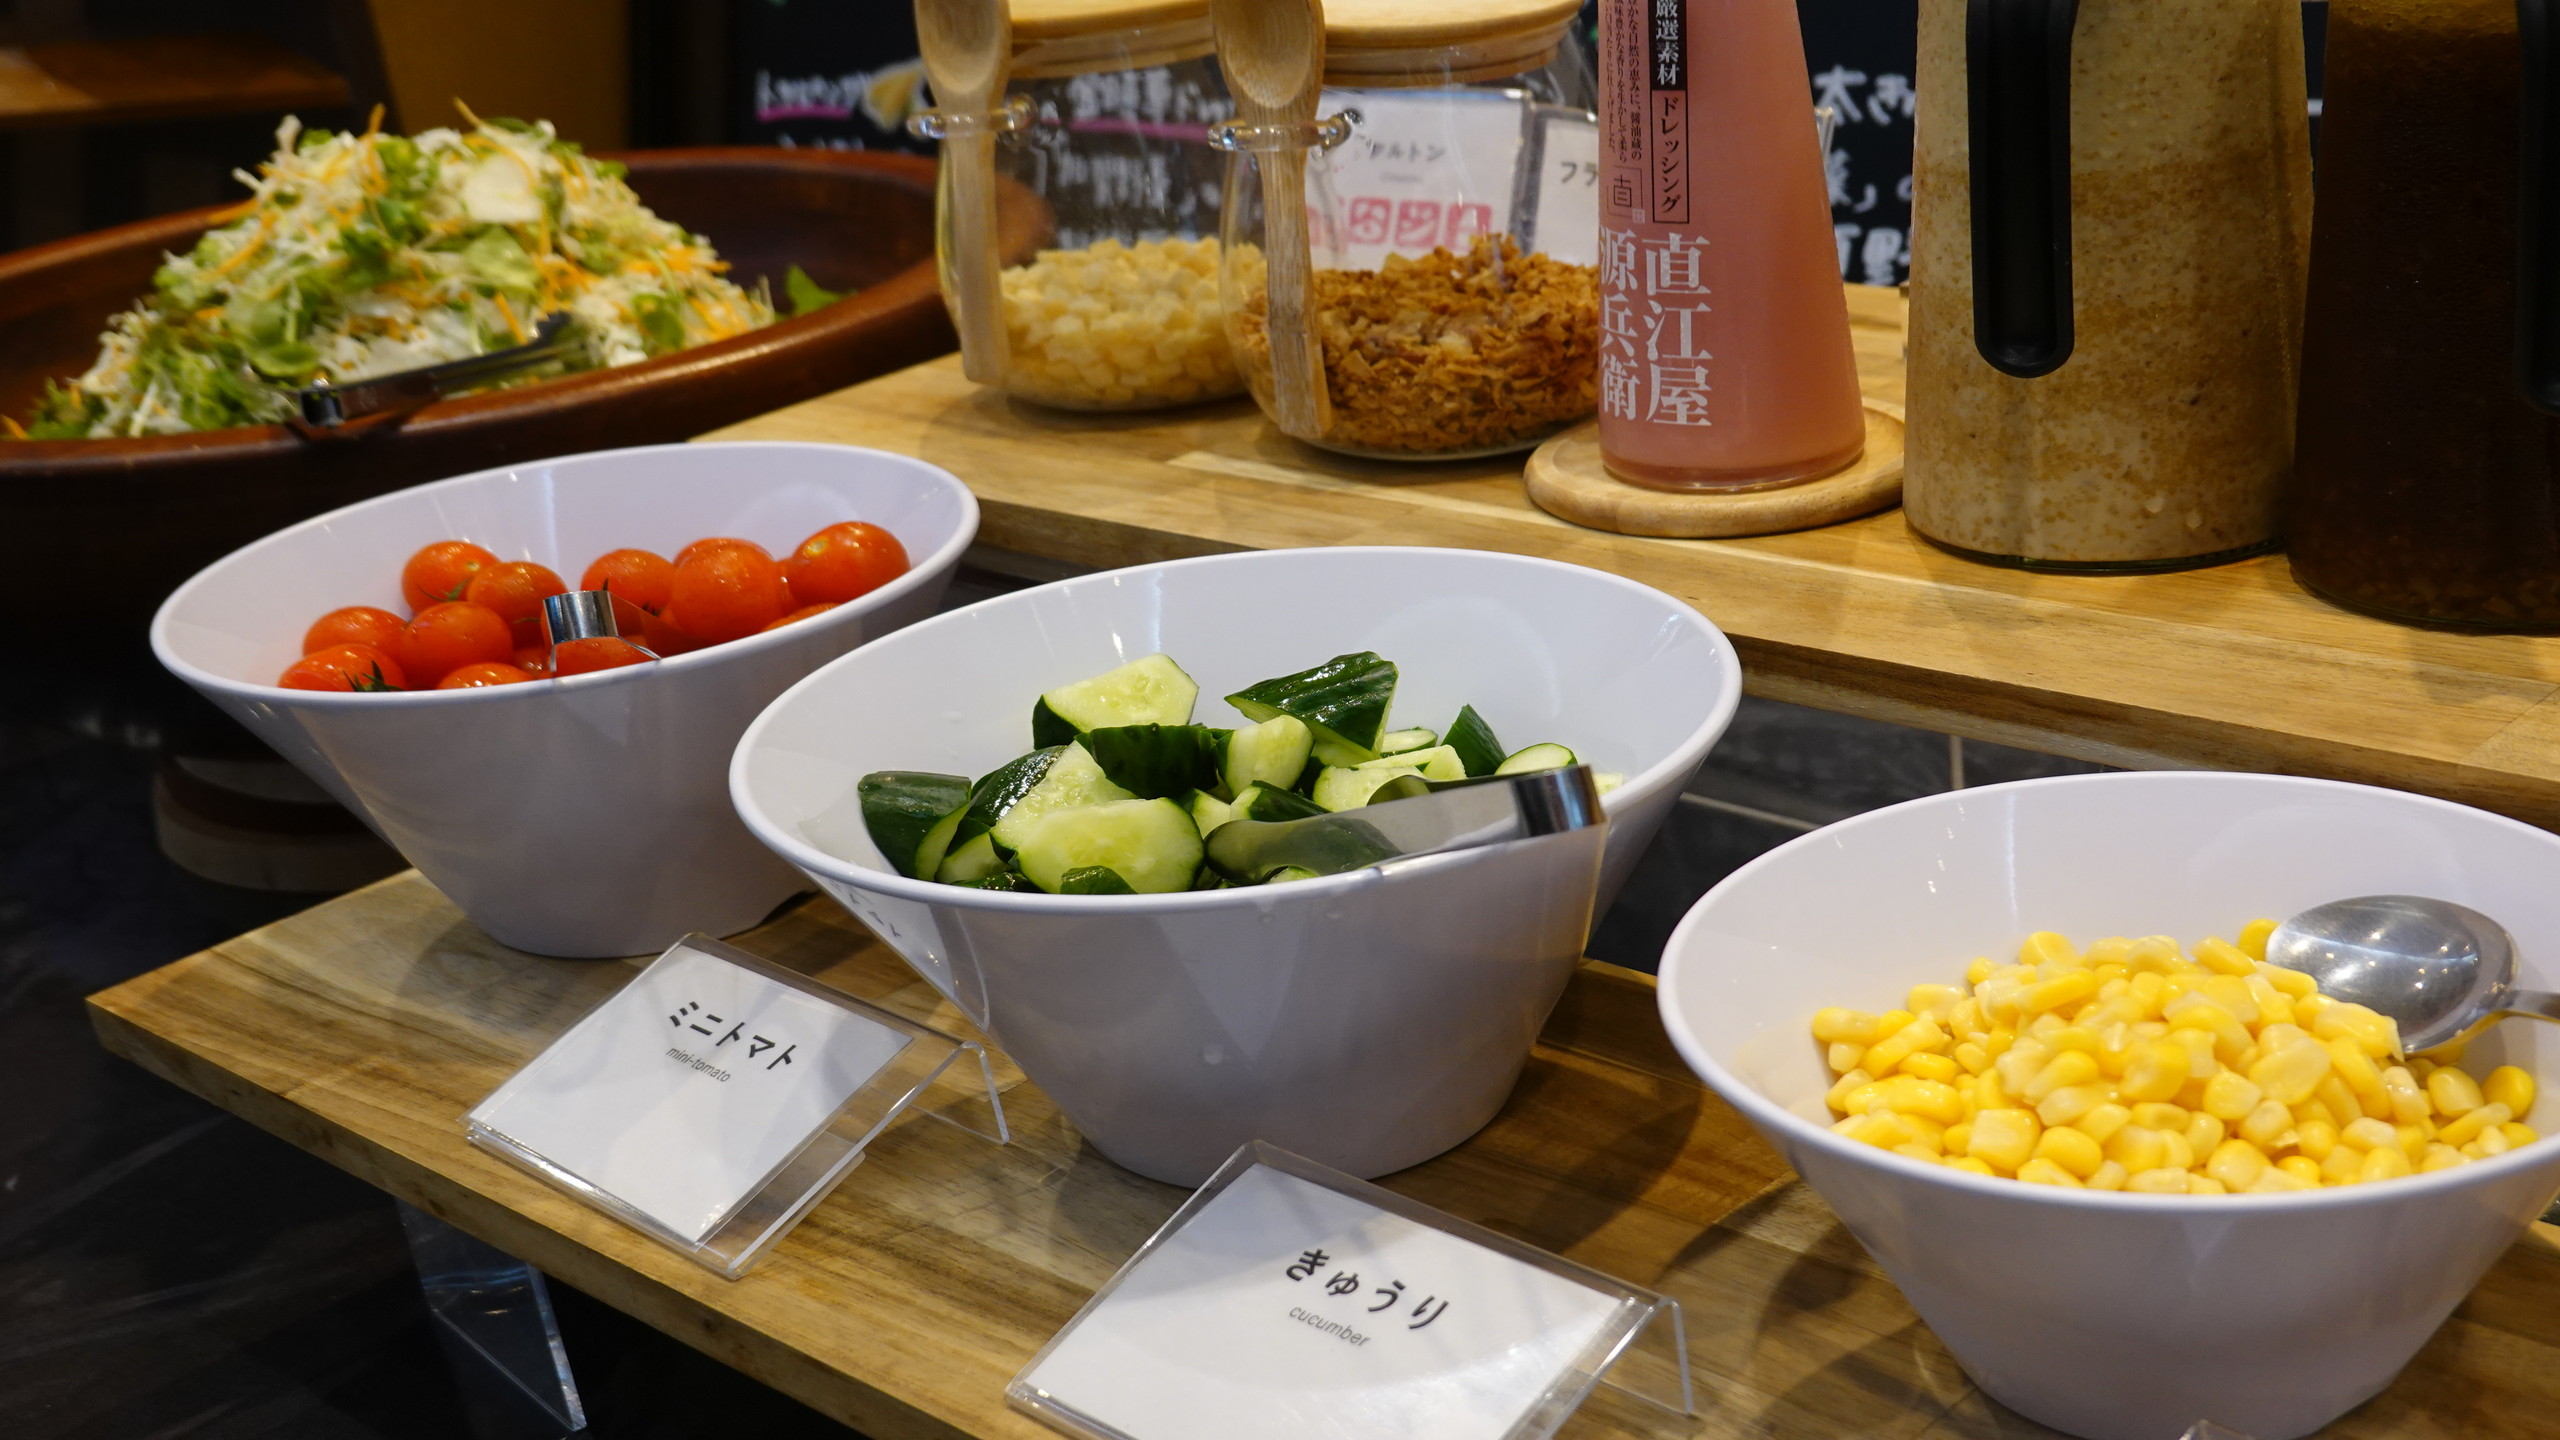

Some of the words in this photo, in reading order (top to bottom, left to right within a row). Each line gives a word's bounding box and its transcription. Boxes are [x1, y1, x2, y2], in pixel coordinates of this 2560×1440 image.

[1661, 96, 1682, 213] ドレッシング
[1600, 226, 1640, 421] 源兵衛
[1642, 232, 1713, 426] 直江屋
[665, 1047, 731, 1083] mini-tomato
[669, 1001, 797, 1070] ミニトマト
[1286, 1248, 1449, 1330] きゅうり
[1289, 1306, 1372, 1347] cucumber
